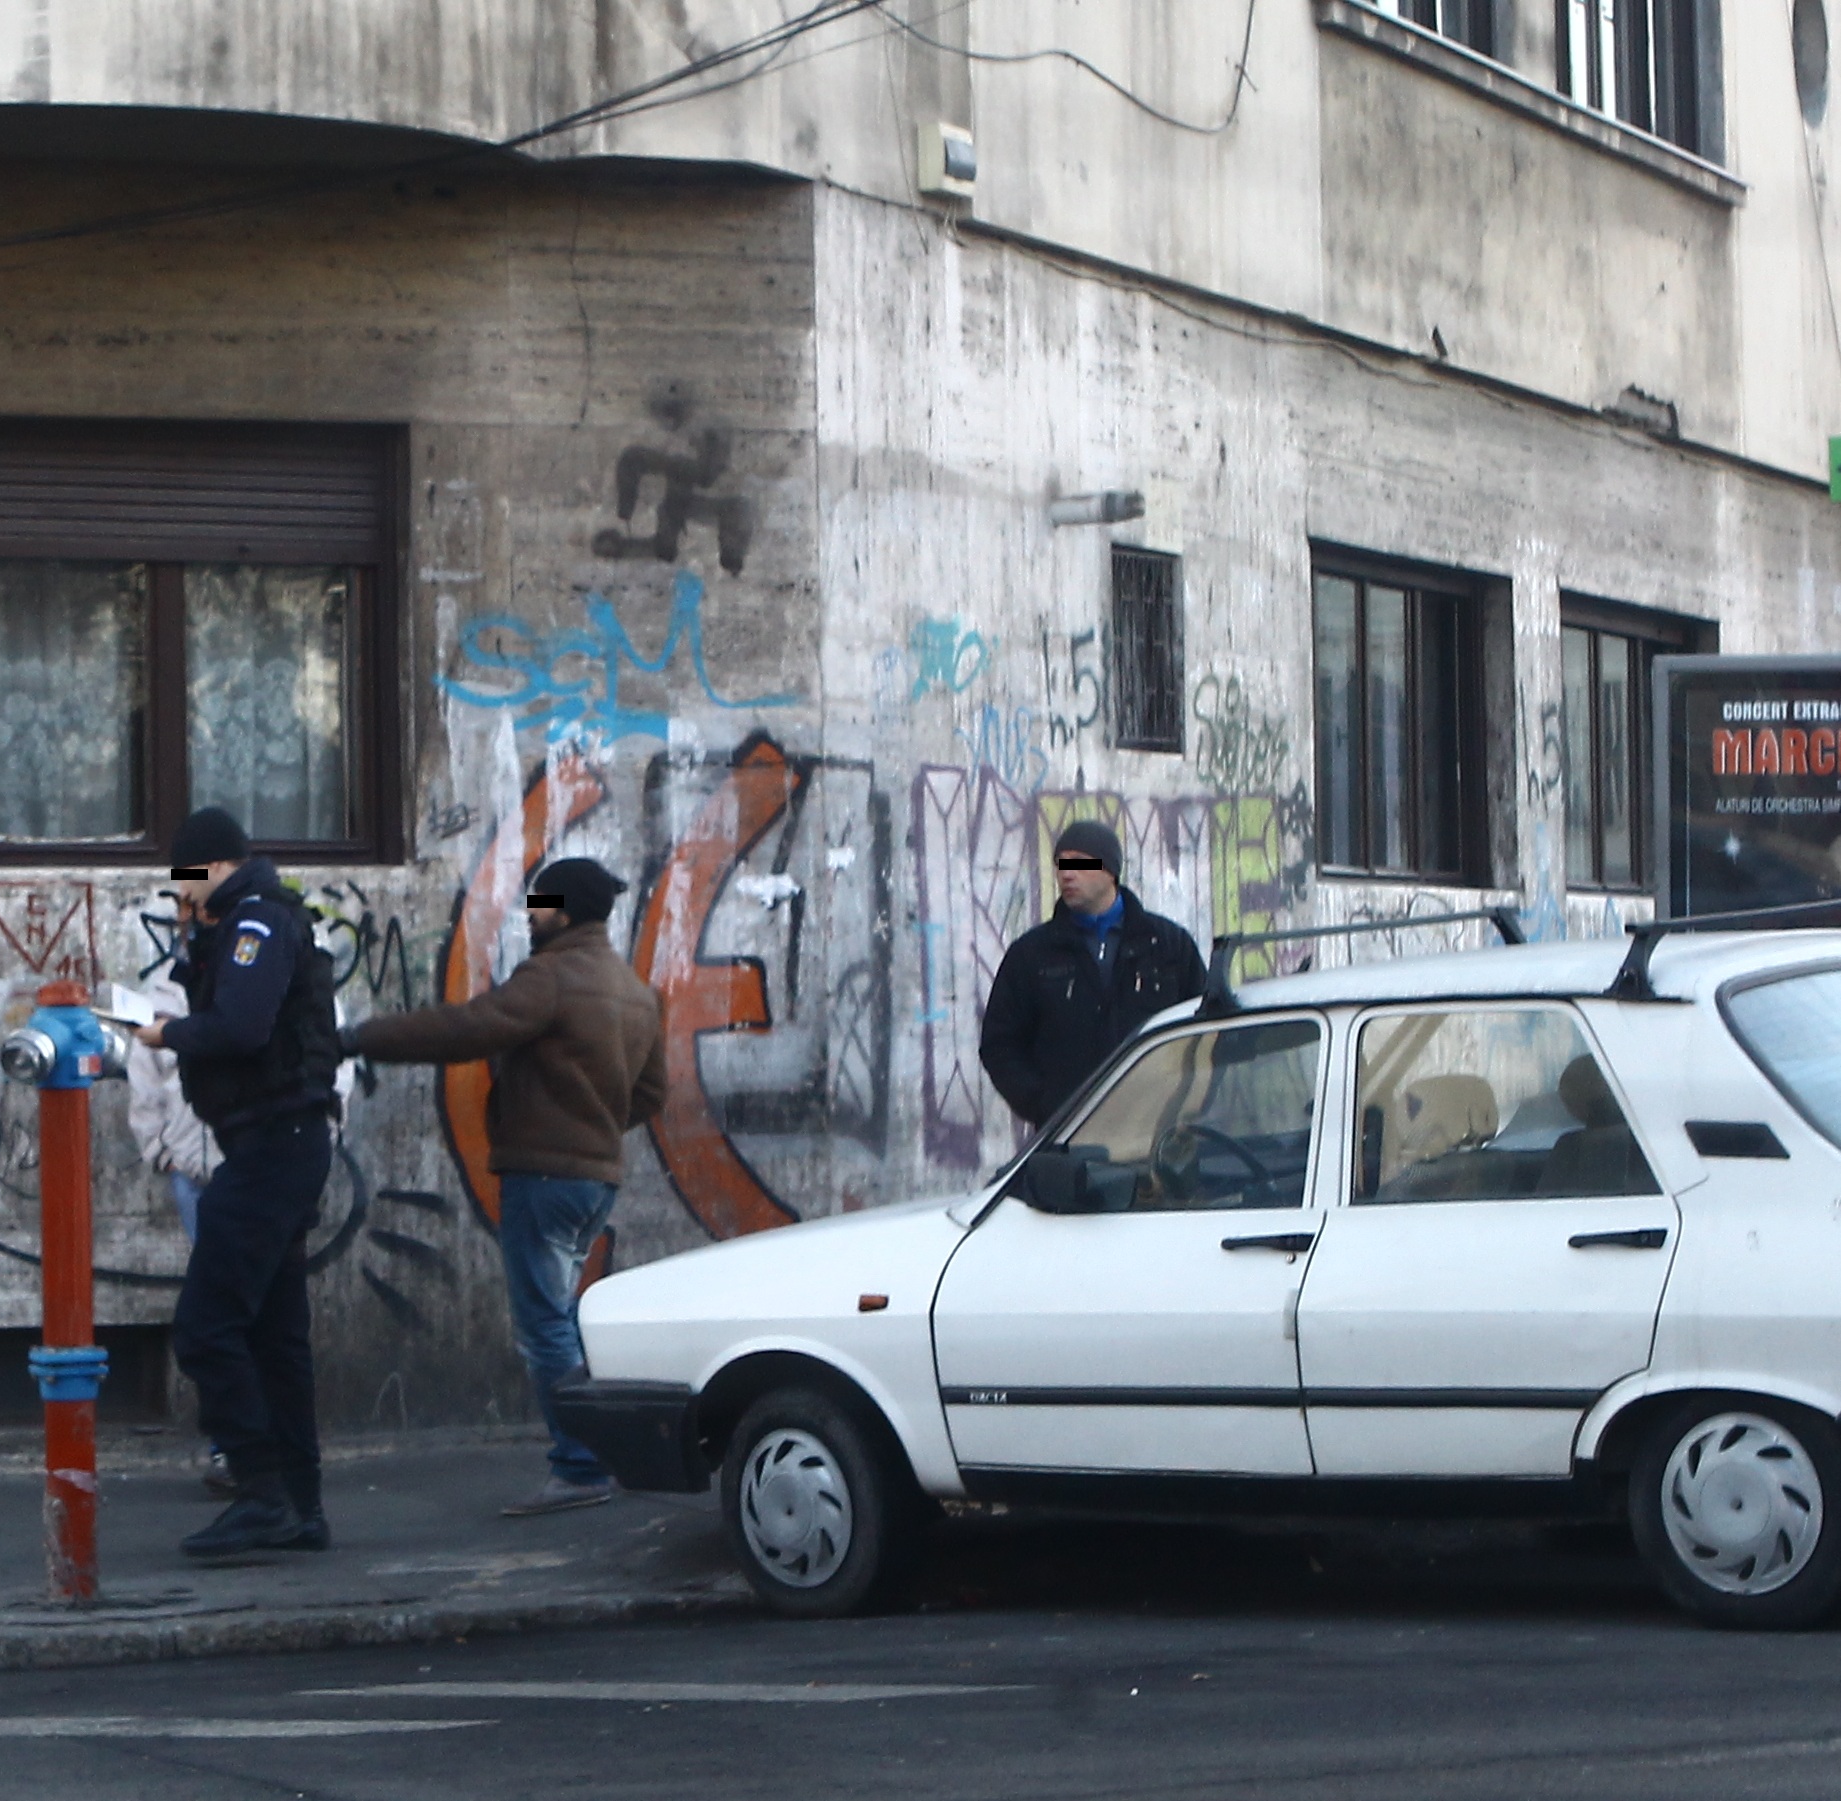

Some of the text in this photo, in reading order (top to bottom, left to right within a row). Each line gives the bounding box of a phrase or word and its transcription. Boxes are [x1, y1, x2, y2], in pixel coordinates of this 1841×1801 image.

[1723, 700, 1841, 721] CONCERT EXTRA
[1712, 728, 1841, 776] MARC
